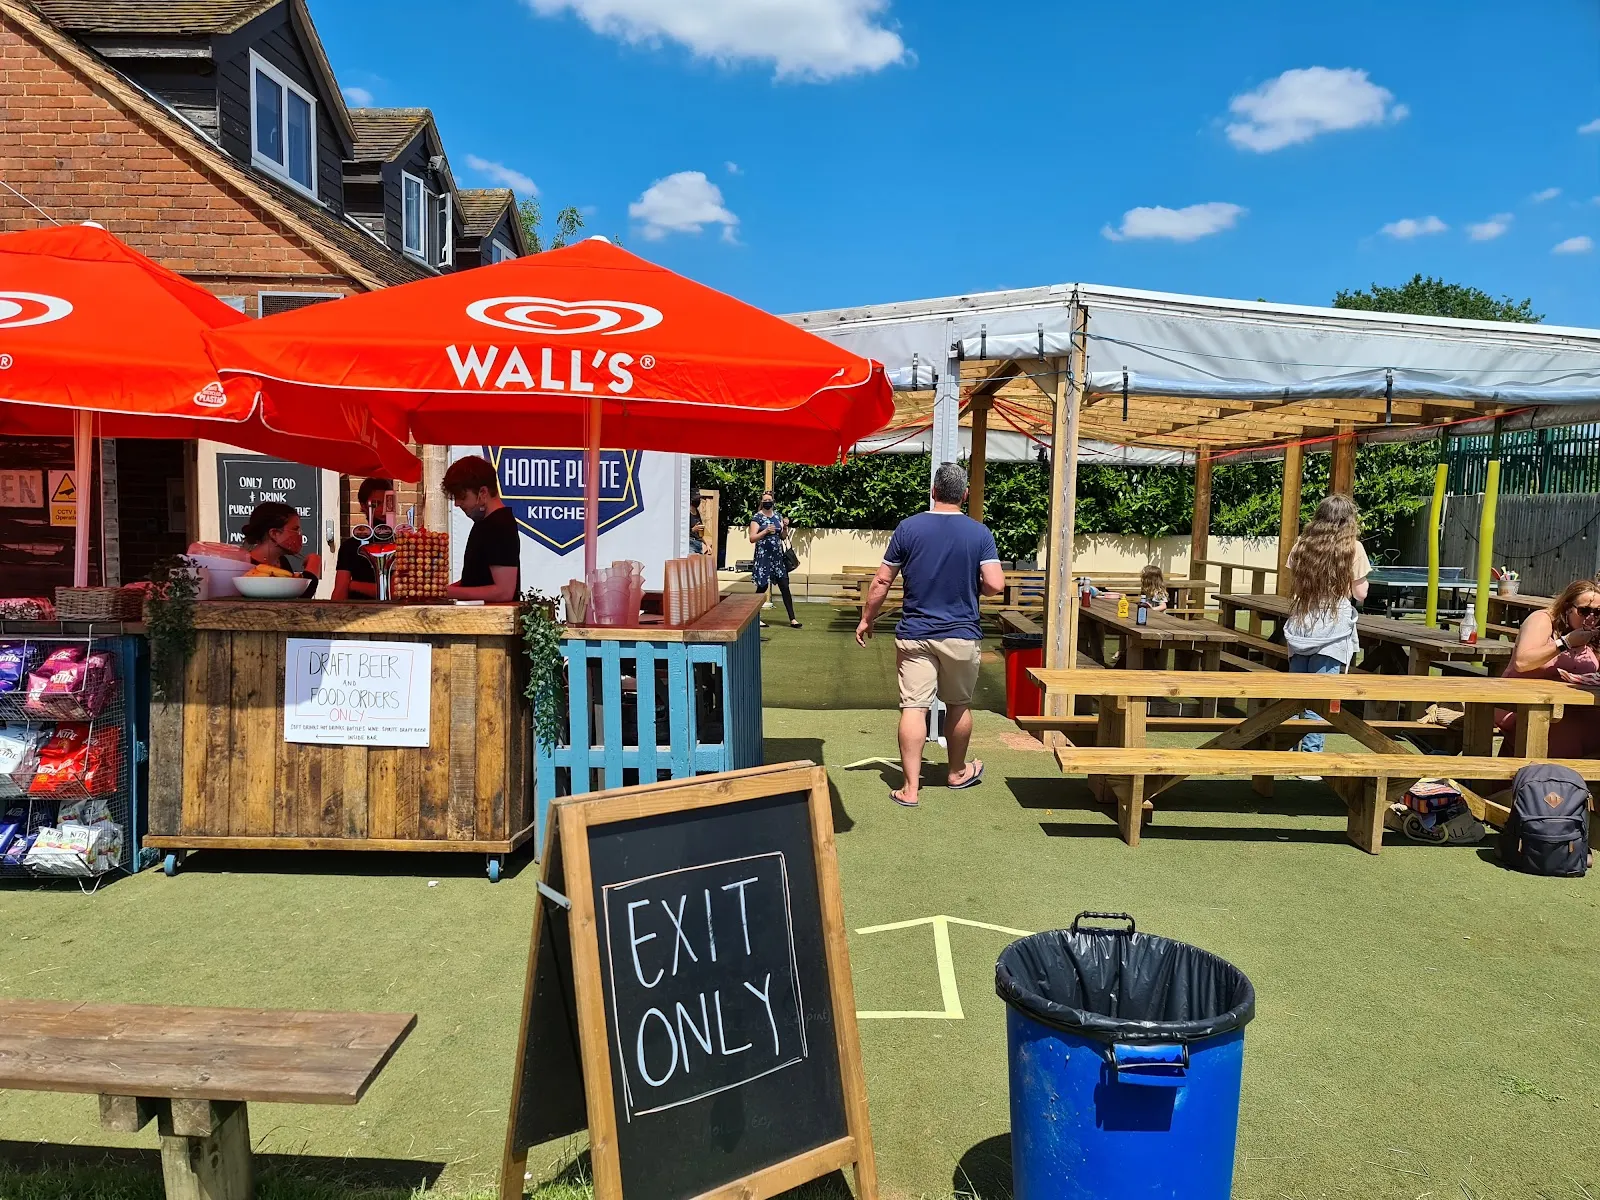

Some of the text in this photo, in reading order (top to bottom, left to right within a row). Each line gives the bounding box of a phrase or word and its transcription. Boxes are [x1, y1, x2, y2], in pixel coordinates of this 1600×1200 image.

[446, 344, 634, 394] WALL'S
[239, 476, 296, 490] ONLY FOOD
[505, 458, 620, 489] HOME PLTE
[260, 491, 287, 502] DRINK
[228, 504, 311, 517] PURCH THE
[309, 651, 400, 679] DRAFT BEER
[310, 687, 400, 709] FOOD ORDERS
[329, 707, 365, 722] ONLY
[627, 876, 759, 988] EXIT
[636, 972, 781, 1087] ONLY
